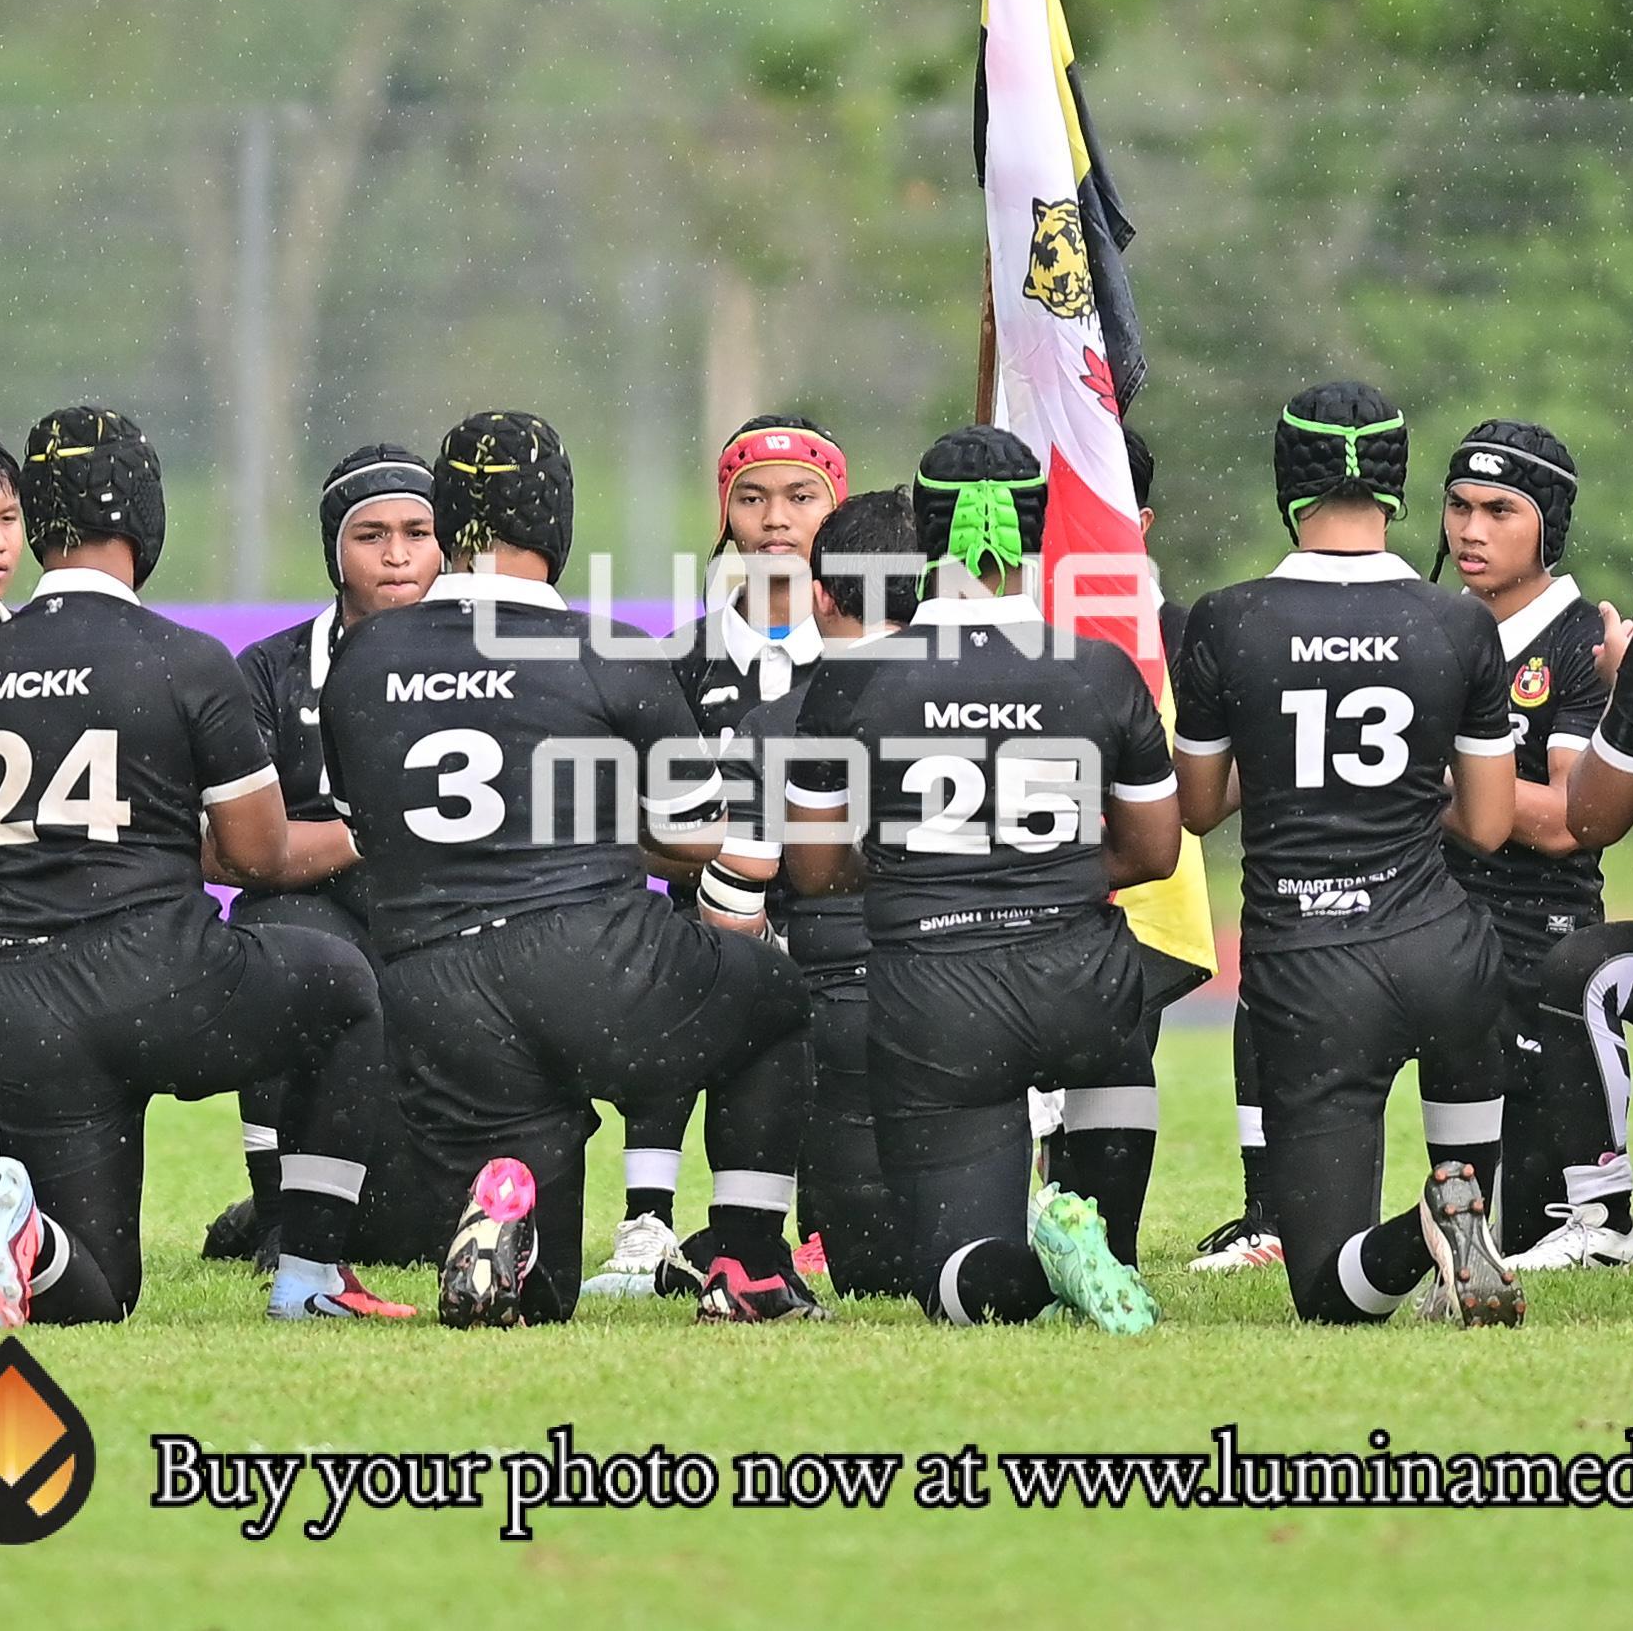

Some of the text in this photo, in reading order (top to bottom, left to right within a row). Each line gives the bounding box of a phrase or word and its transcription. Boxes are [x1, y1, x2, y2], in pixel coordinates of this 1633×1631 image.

[1291, 636, 1399, 662] MCKK
[386, 669, 517, 702] MCKK
[924, 701, 1043, 731] MCKK
[1280, 686, 1415, 788] 13
[403, 728, 506, 844] 3
[901, 755, 1078, 854] 25
[1277, 878, 1334, 895] SMART
